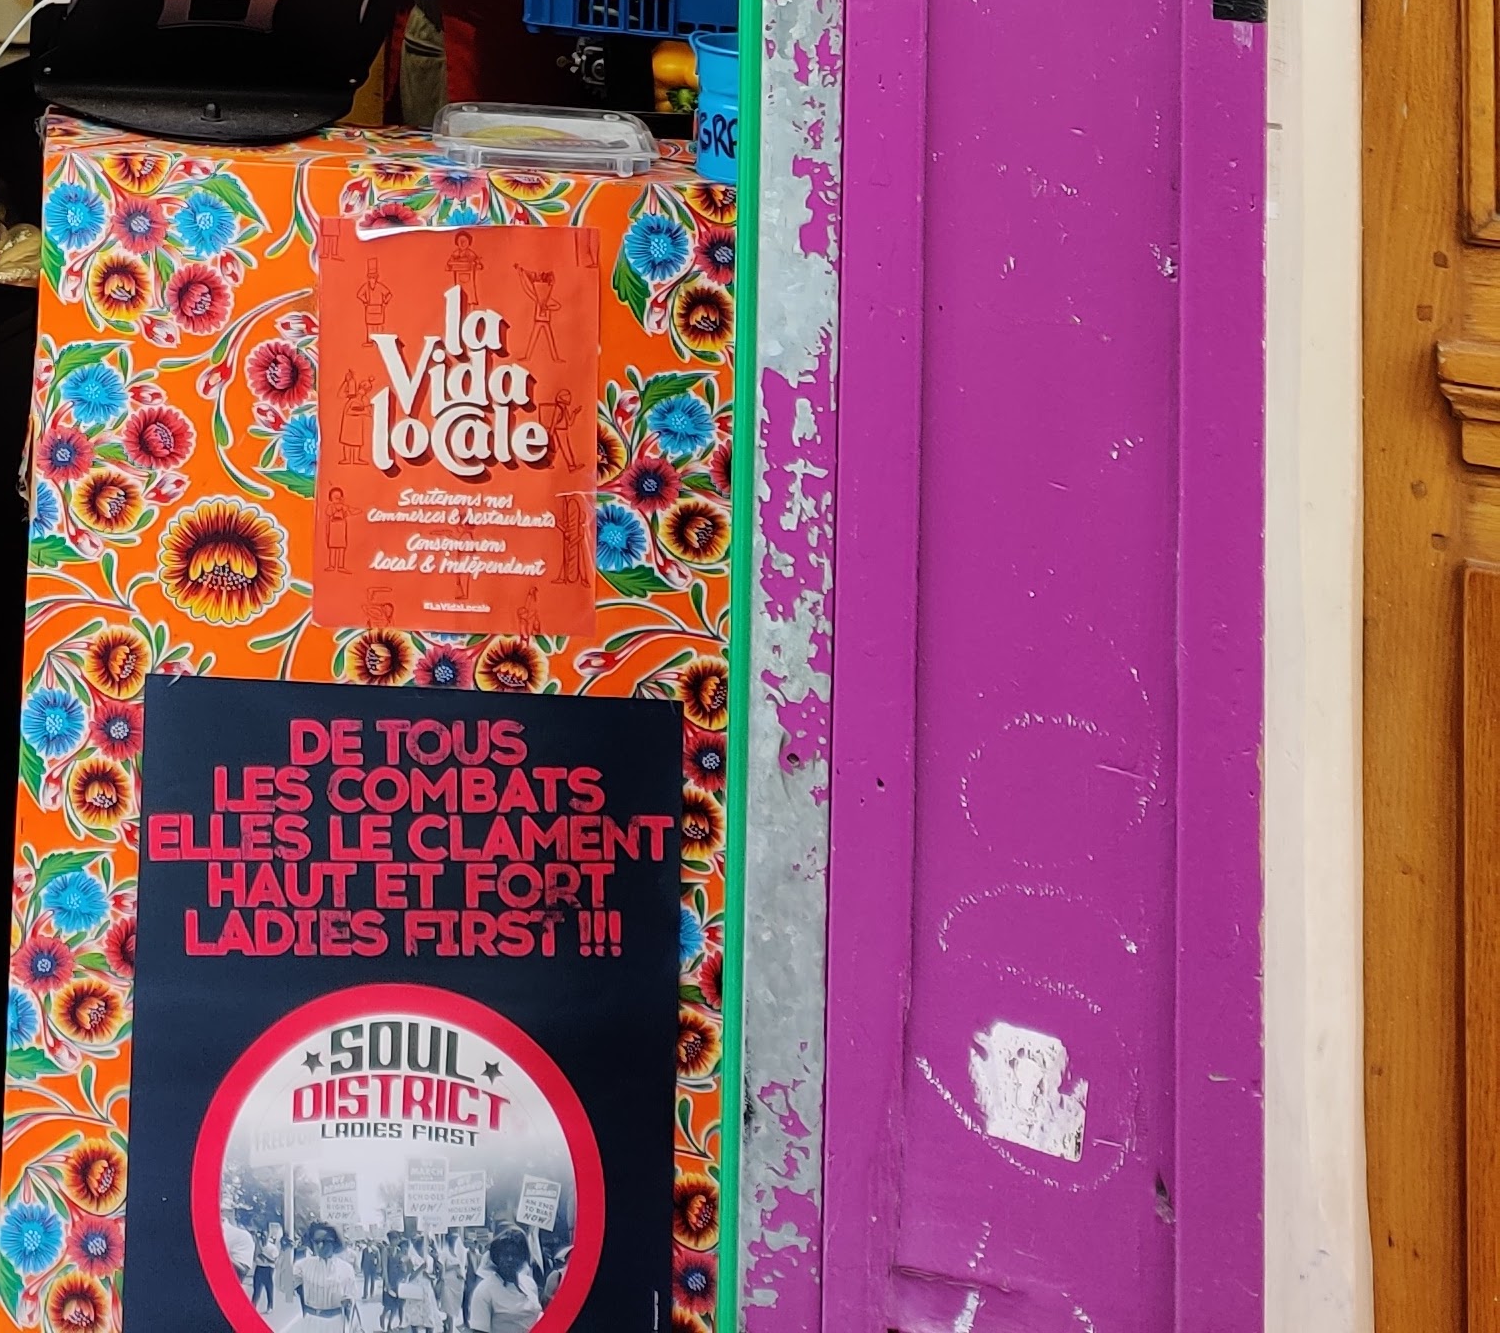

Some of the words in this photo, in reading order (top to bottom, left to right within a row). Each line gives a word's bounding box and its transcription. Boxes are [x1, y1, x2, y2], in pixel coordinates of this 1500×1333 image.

[443, 283, 504, 357] la
[370, 333, 531, 417] Vida
[366, 509, 446, 525] commerces
[446, 509, 461, 525] &
[463, 508, 557, 529] restaurants
[397, 487, 482, 508] Soutenons
[482, 491, 513, 509] nos
[368, 551, 417, 573] local
[418, 554, 436, 573] &
[438, 551, 548, 580] indépendant
[405, 533, 507, 554] Consommons
[288, 718, 364, 766] DE
[375, 719, 529, 767] TOUS
[212, 765, 314, 815] LES
[325, 766, 607, 815] COMBATS
[146, 813, 312, 863] ELLES
[327, 814, 393, 863] LE
[405, 814, 675, 863] CLAMENT
[207, 861, 358, 909] HAUT
[374, 863, 445, 910] ET
[463, 863, 616, 910] FORT
[183, 909, 389, 958] LADIES
[402, 910, 565, 958] FIRST
[576, 909, 623, 958] !!!
[329, 1020, 477, 1084] SOUL
[291, 1072, 512, 1132] DISTRICT
[320, 1121, 404, 1140] LADIES
[411, 1123, 480, 1148] FIRST
